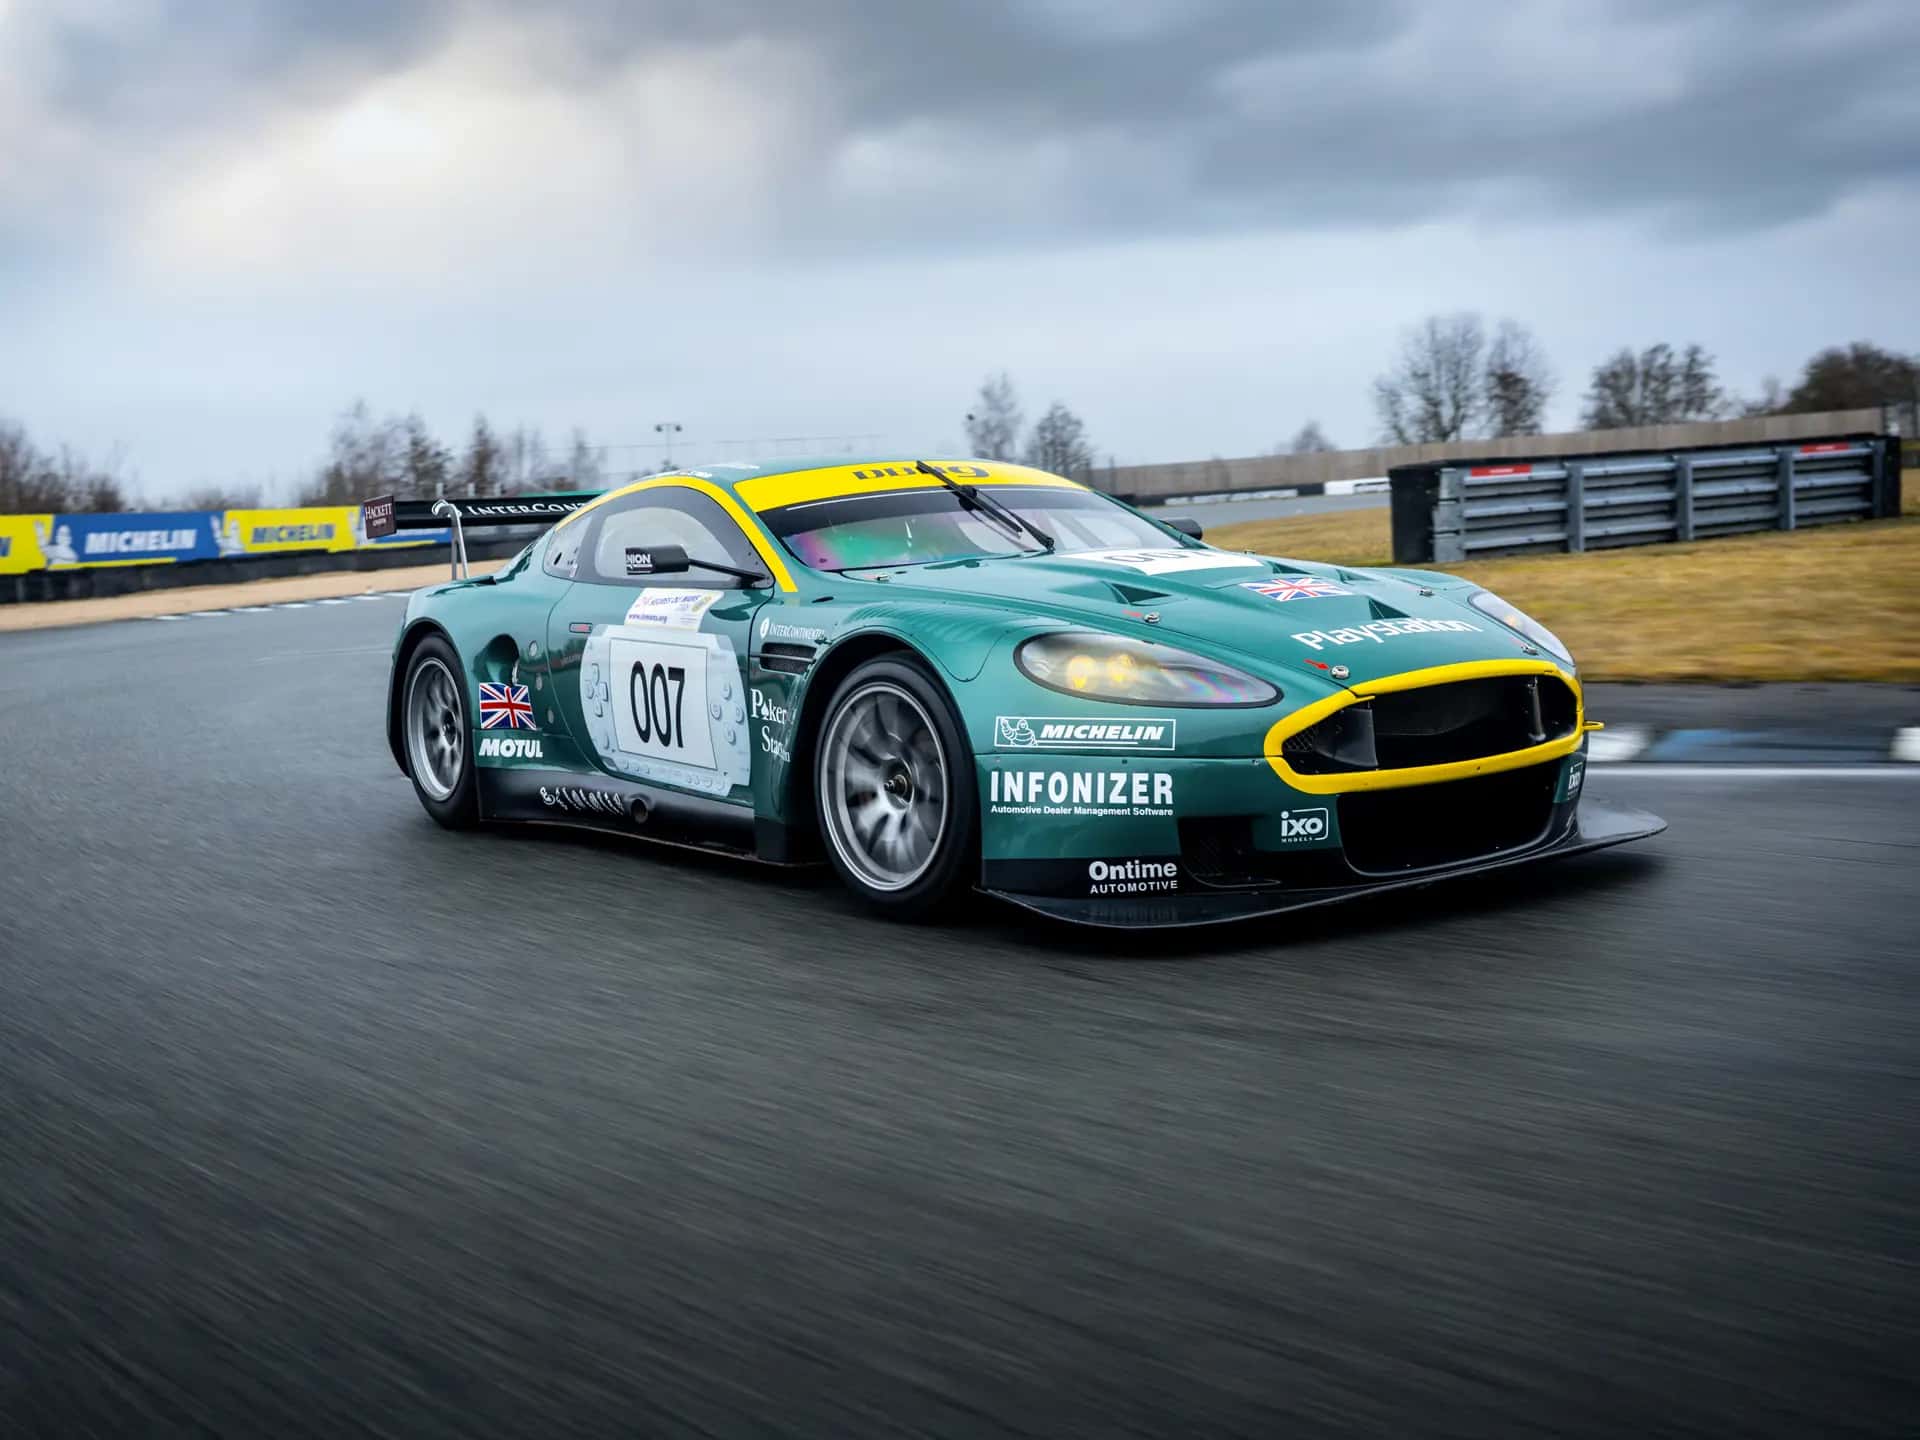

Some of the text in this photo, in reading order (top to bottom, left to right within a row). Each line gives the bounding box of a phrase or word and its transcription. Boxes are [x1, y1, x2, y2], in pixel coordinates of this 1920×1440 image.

[365, 503, 392, 520] HACKETT
[84, 529, 197, 554] MICHELIN
[251, 524, 336, 544] MICHELIN
[630, 660, 685, 748] 007
[1041, 724, 1165, 740] MICHELIN
[479, 738, 544, 758] MOTUL
[991, 771, 1173, 805] INFONIZER
[991, 805, 1174, 817] Automotive Dealer Management Software
[1088, 860, 1178, 881] Ontime
[1090, 880, 1179, 895] AUTOMOTIVE
